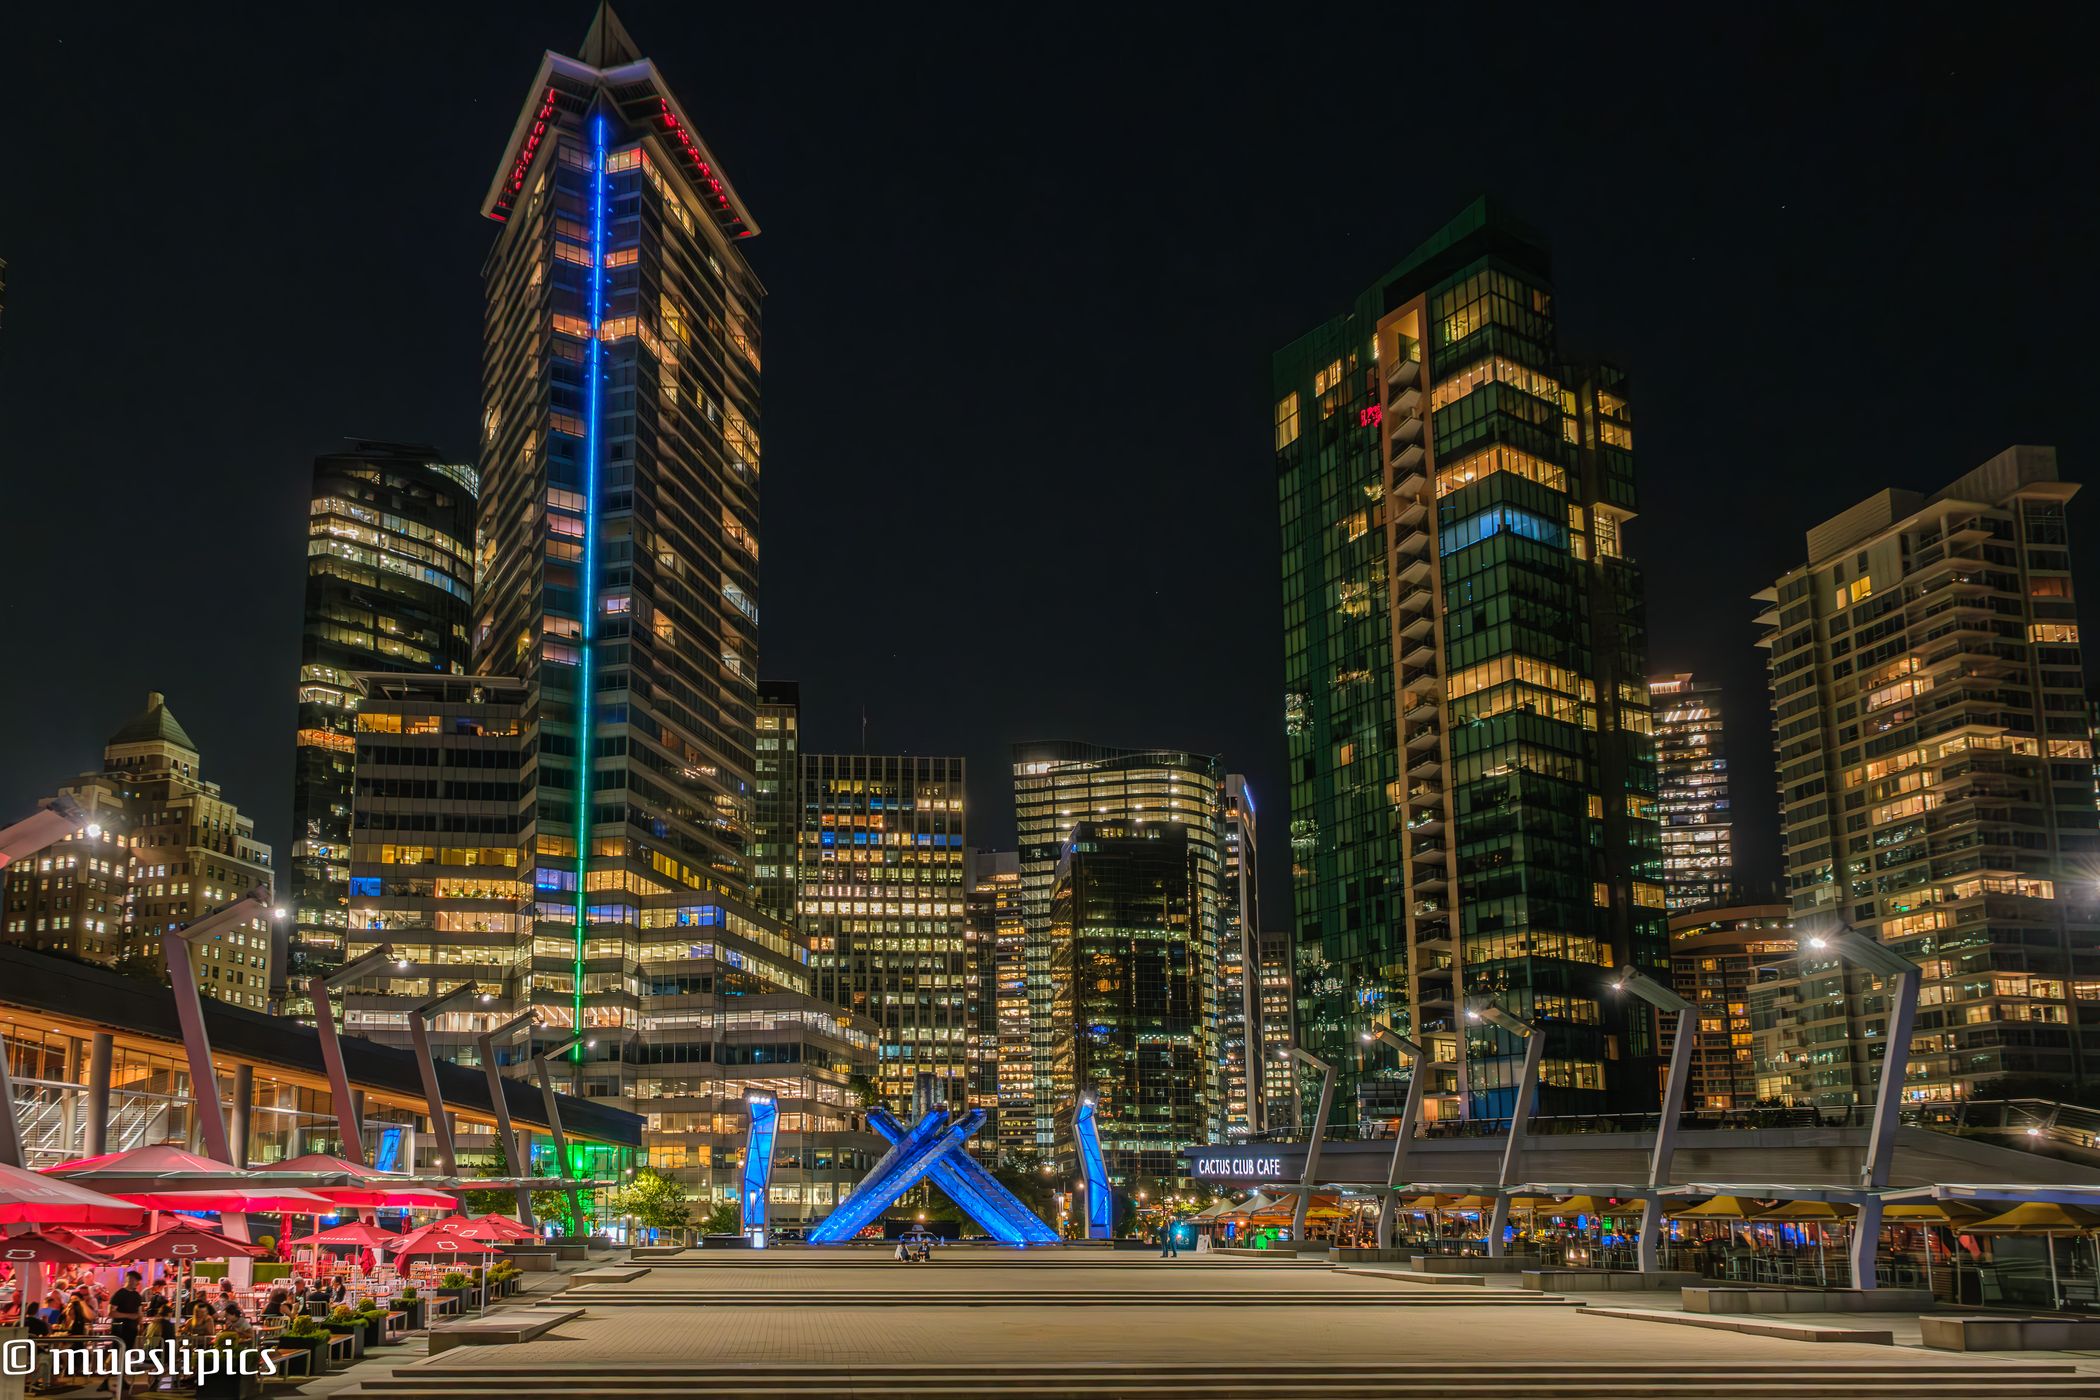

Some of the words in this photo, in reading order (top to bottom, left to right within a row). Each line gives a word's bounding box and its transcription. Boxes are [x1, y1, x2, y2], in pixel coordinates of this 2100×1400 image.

[1199, 1159, 1230, 1174] CACTUS
[1232, 1159, 1254, 1175] CLUB
[1257, 1159, 1280, 1175] CAFE
